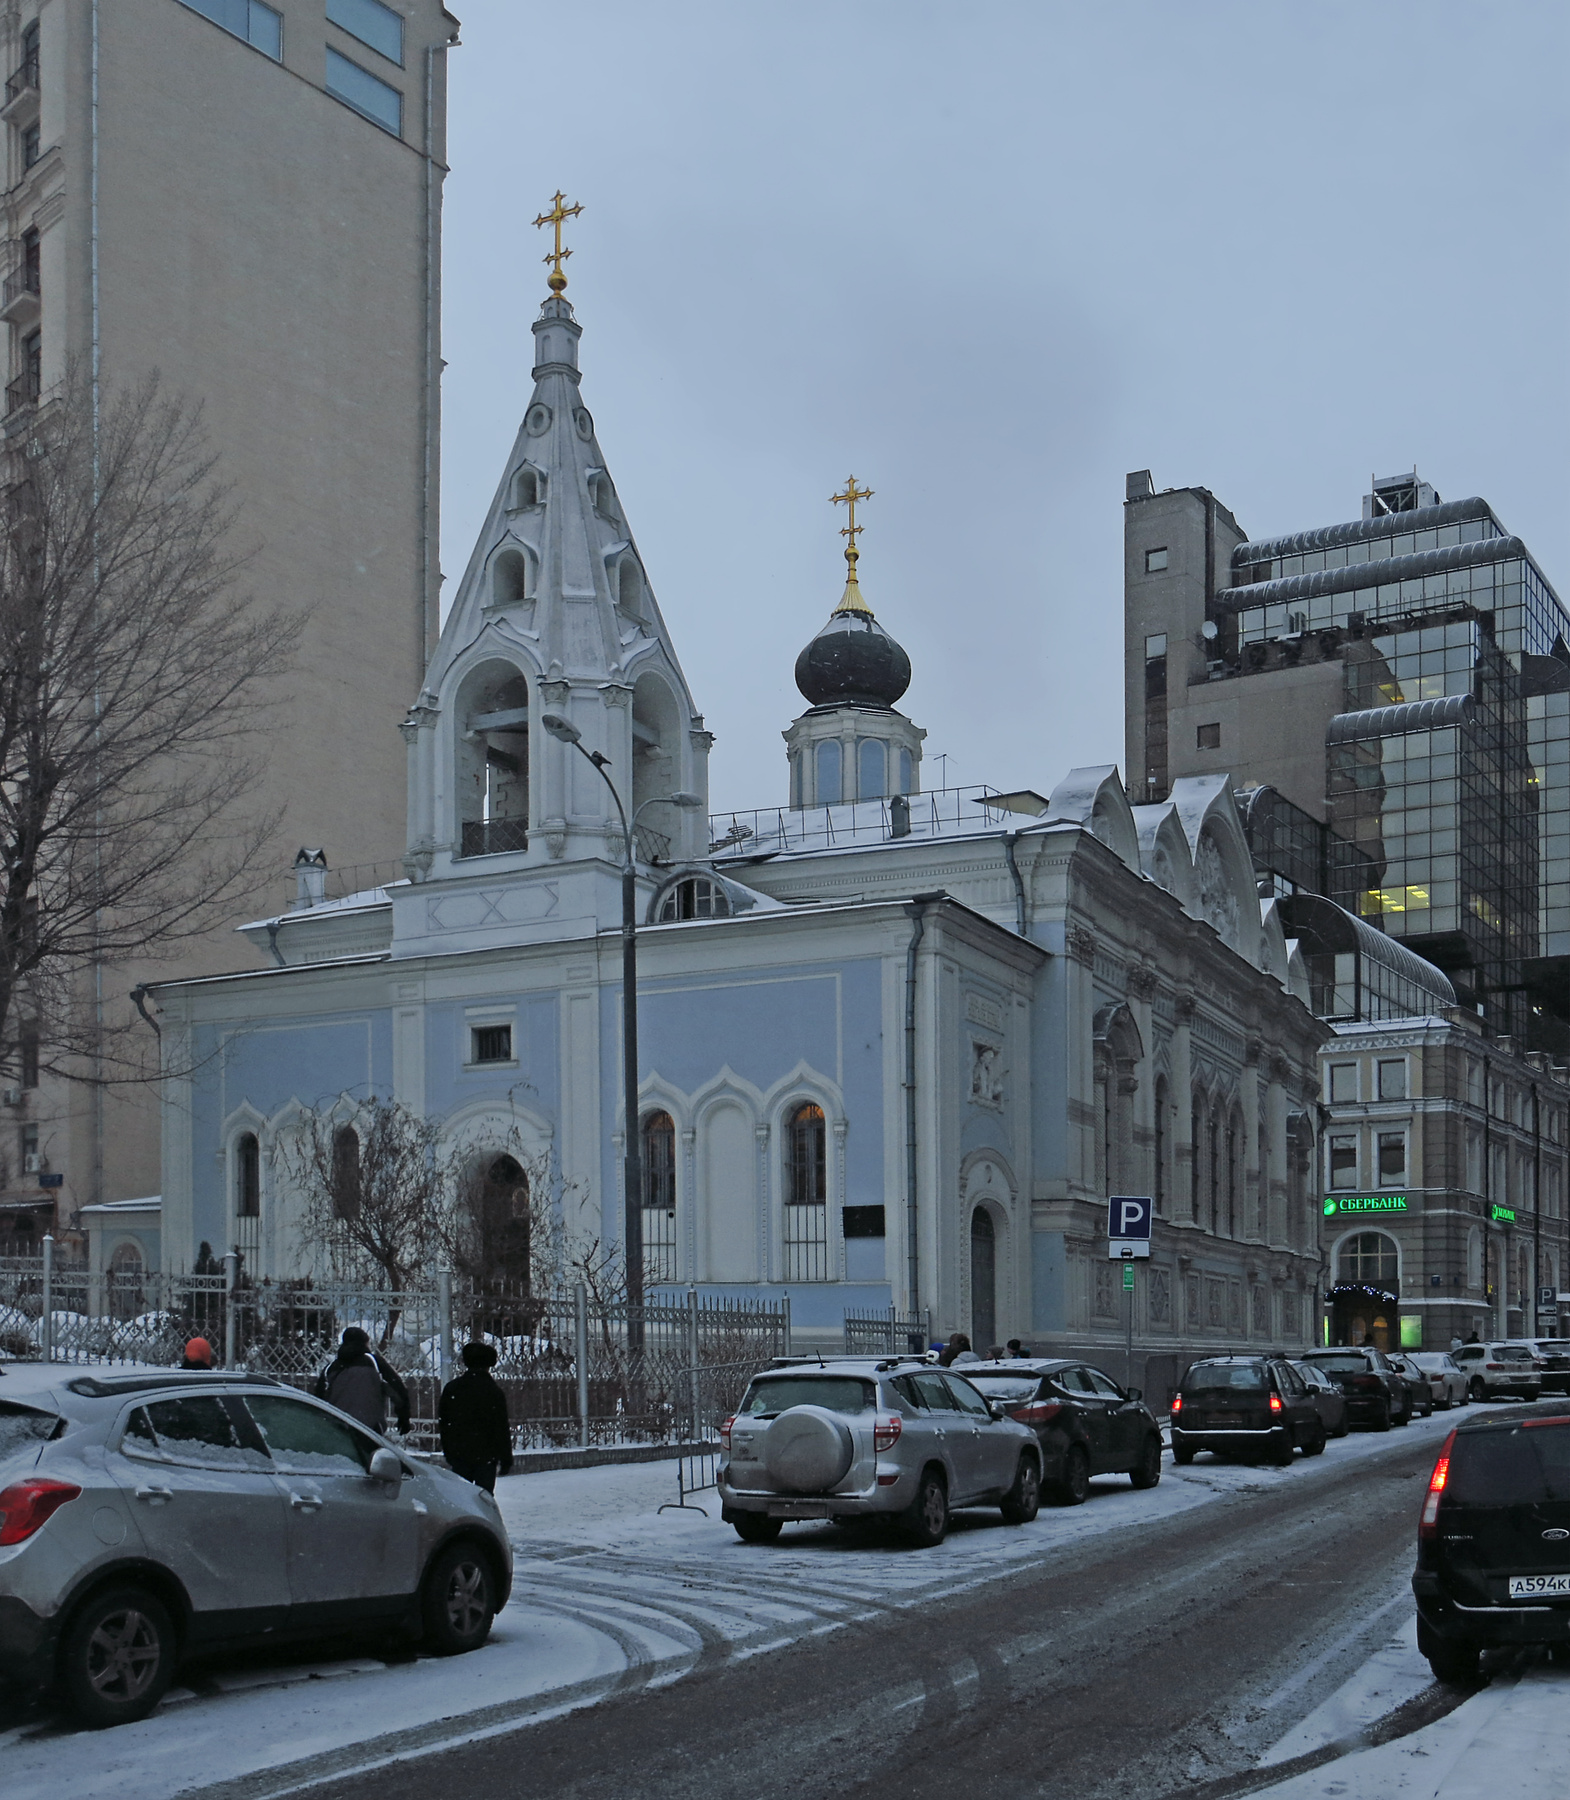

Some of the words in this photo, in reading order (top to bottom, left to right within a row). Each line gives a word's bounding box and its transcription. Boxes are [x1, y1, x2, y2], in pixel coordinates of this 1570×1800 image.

[1339, 1196, 1407, 1210] СБЕРБАНК
[1120, 1201, 1144, 1234] P
[1541, 1289, 1552, 1304] P
[1515, 1577, 1570, 1592] А594К
